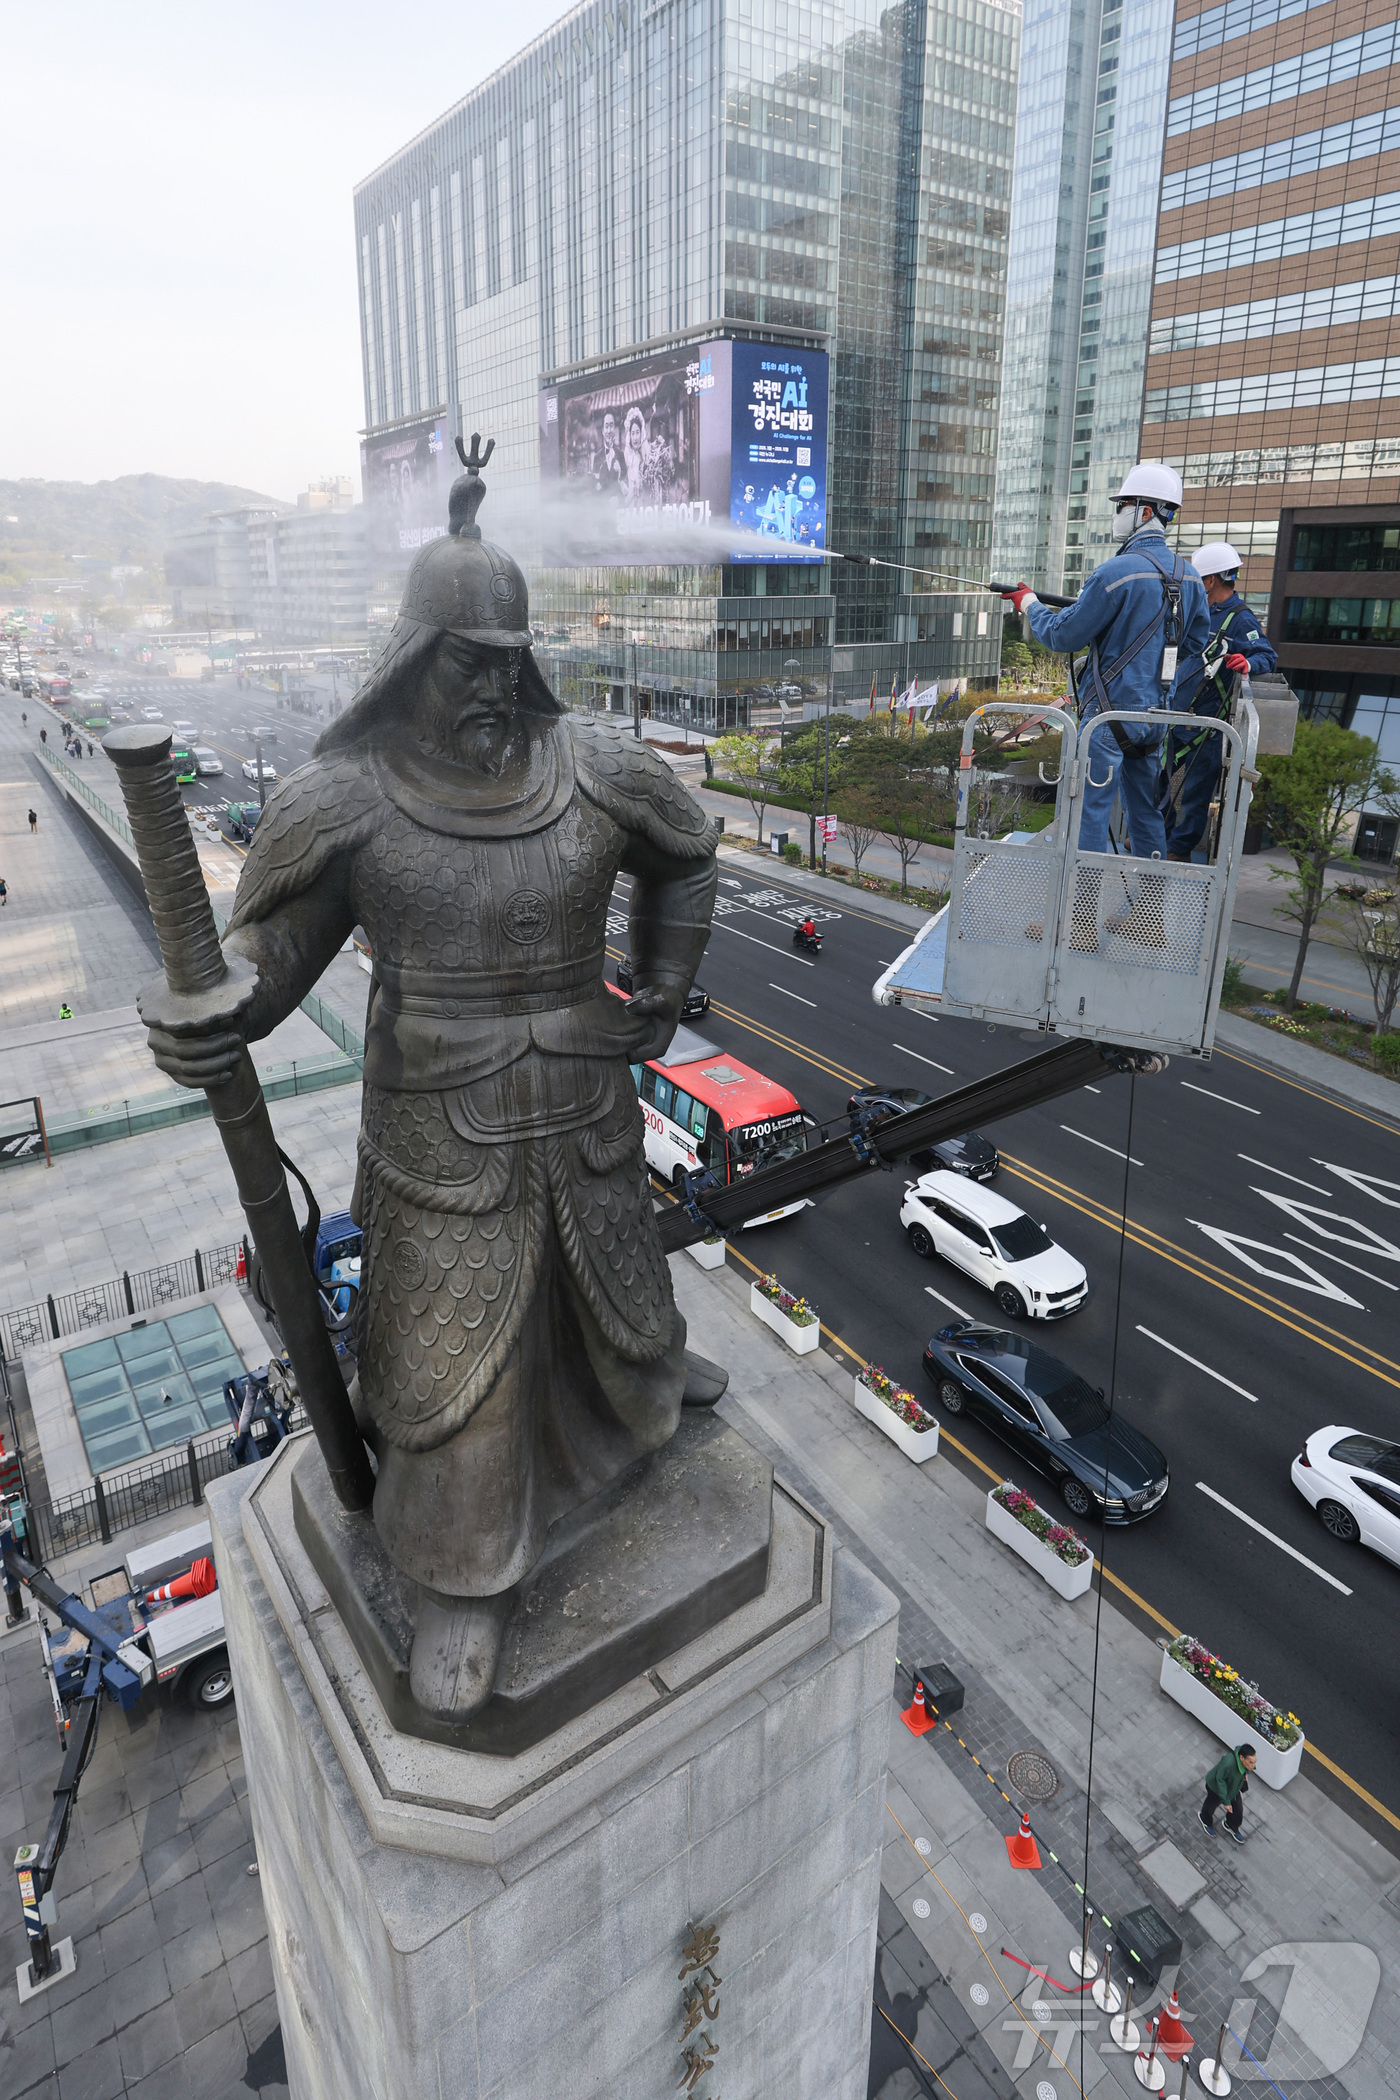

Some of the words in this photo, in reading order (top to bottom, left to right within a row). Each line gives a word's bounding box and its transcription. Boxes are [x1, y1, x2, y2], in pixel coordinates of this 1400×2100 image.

[700, 353, 712, 377] AI
[761, 361, 776, 372] 모두의
[778, 362, 790, 374] AI를
[791, 364, 803, 375] 위한
[753, 379, 782, 400] 전국민
[781, 376, 808, 409] AI
[748, 400, 813, 431] 경진대회
[617, 505, 658, 534] 당신의
[662, 500, 712, 532] 참여가
[639, 1104, 664, 1135] 200
[742, 1122, 772, 1140] 7200
[676, 1924, 722, 2100] 忠武公
